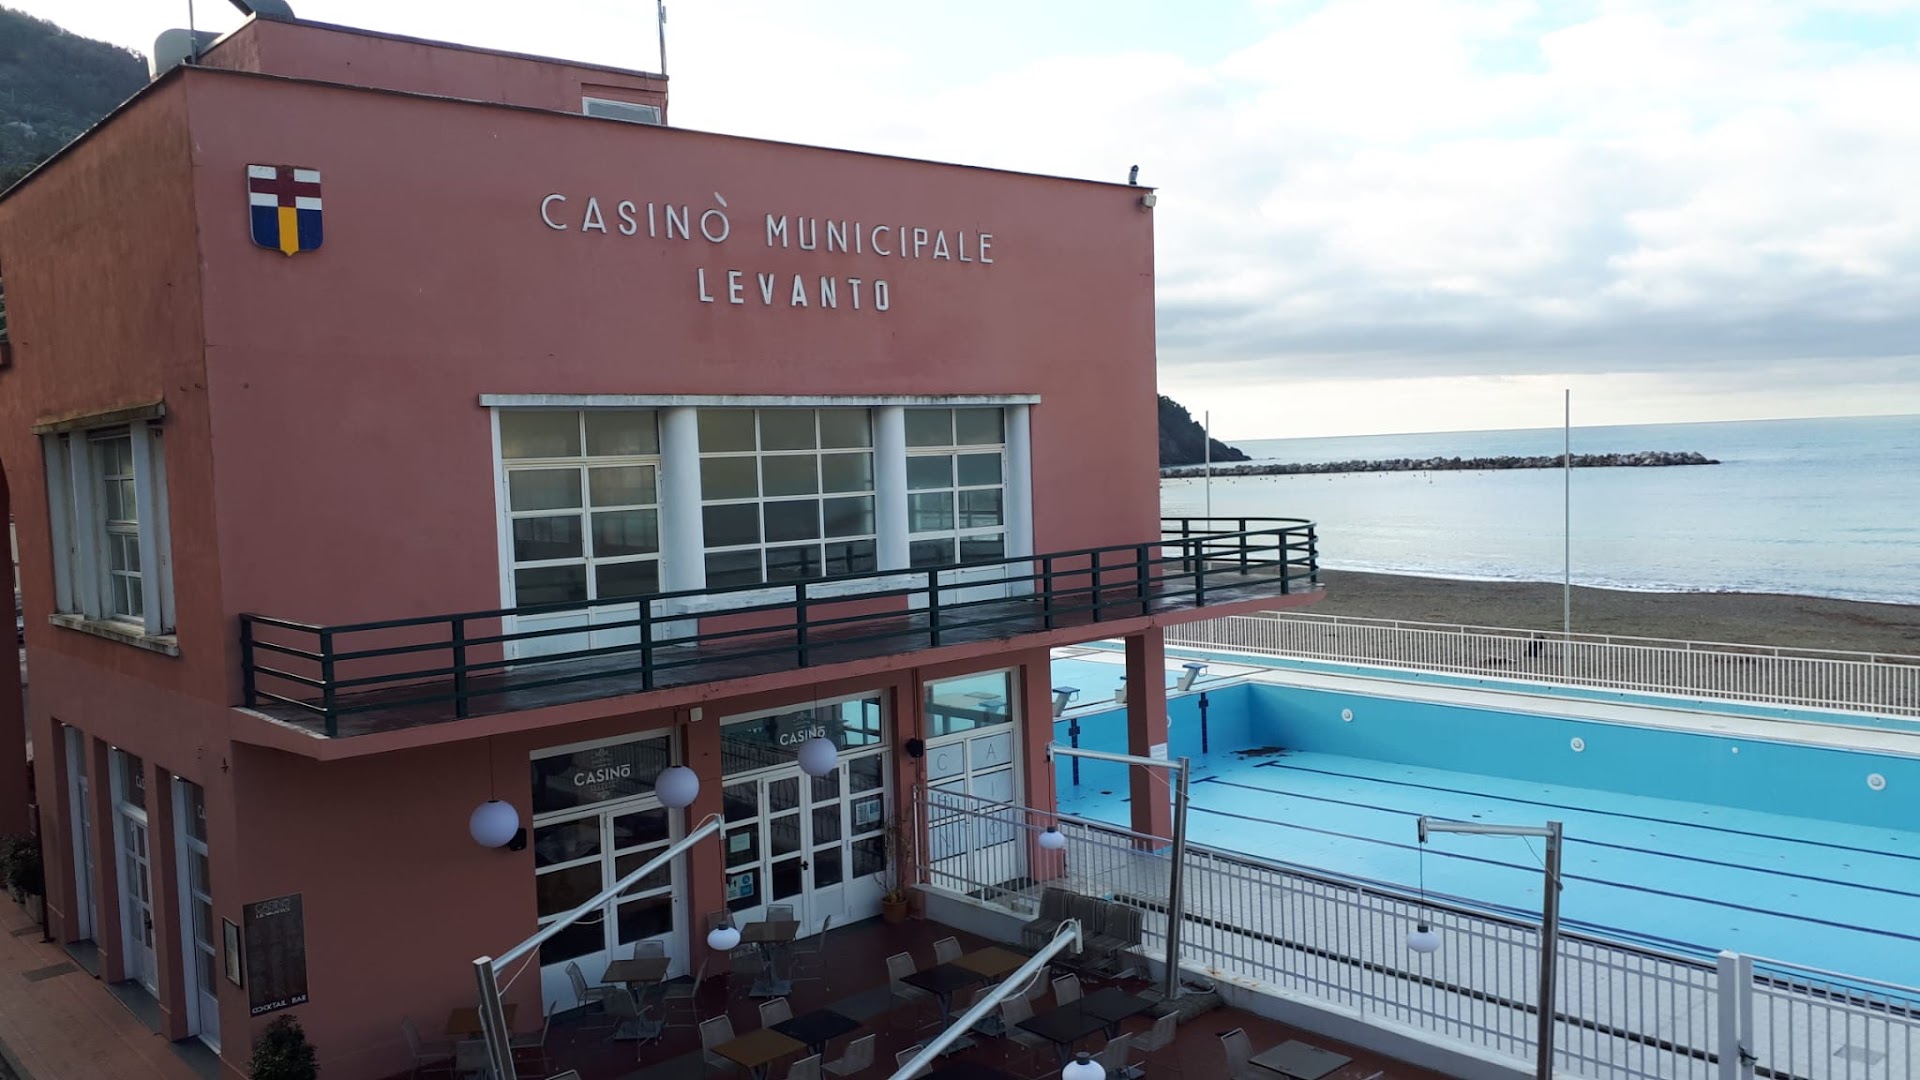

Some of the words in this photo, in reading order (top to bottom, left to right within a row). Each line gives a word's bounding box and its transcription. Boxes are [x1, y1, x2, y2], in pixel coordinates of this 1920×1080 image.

[540, 191, 730, 243] CASINÒ
[766, 213, 994, 264] MUNICIPALE
[698, 268, 890, 311] LEVANTO
[252, 1000, 287, 1013] COCKTAIL
